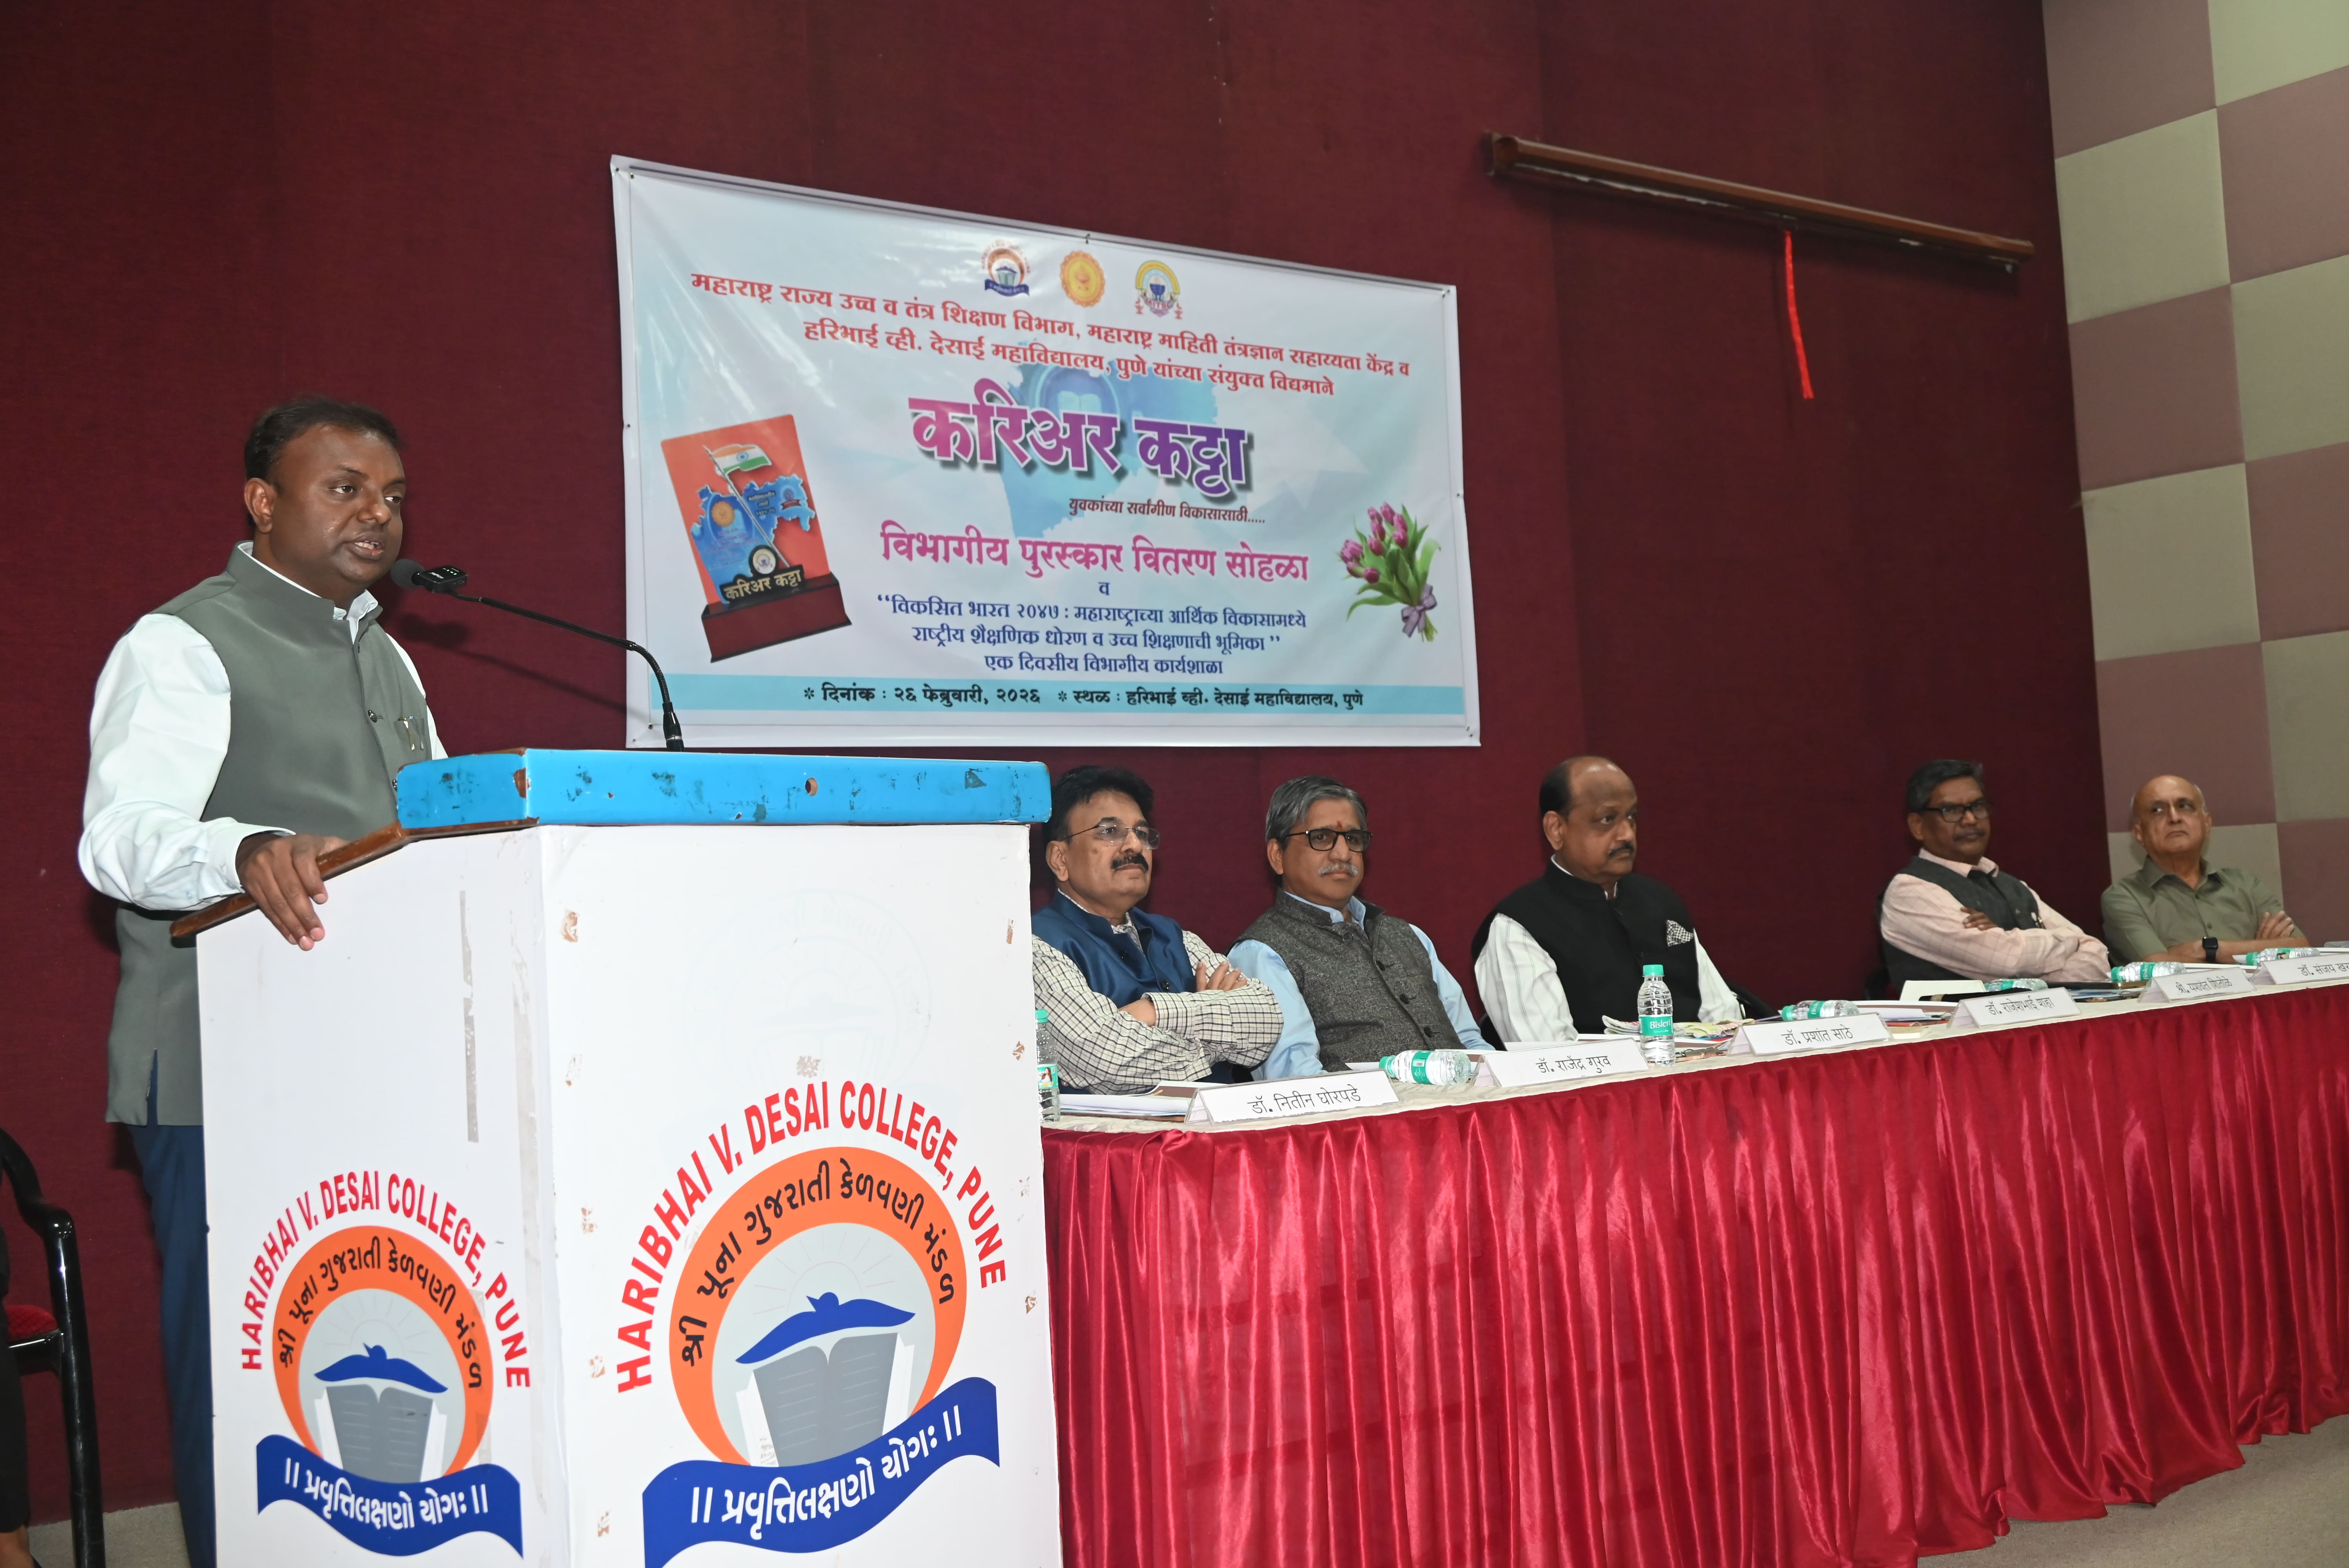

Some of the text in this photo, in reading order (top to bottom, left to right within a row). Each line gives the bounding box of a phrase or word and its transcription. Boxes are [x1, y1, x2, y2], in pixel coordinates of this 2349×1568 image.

[691, 273, 1410, 376] महाराष्ट्र राज्य उच्च व तंत्र शिक्षण विभाग, महाराष्ट्र माहिती तंत्रज्ञान सहाय्यता केंद्र व
[803, 317, 1334, 395] हरिभाई व्ही. देसाई महाविद्यालय, पुणे यांच्या संयुक्त विद्यमाने
[908, 377, 1249, 497] करिअर कट्टा
[1069, 496, 1123, 515] युवकांच्या
[880, 520, 1308, 582] विभागीय पुरस्कार वितरण सोहळा
[724, 570, 802, 599] करिअर कट्टा
[1099, 582, 1110, 595] व
[969, 602, 1010, 617] भारत
[1017, 604, 1059, 618] २०४७
[1074, 606, 1163, 626] महाराष्ट्राच्या
[1169, 606, 1218, 624] आर्थिक
[1223, 608, 1306, 627] विकासामध्ये
[912, 623, 964, 647] राष्ट्रीय
[971, 624, 1039, 646] शैक्षणिक
[1045, 626, 1087, 645] धोरण
[1093, 632, 1103, 647] व
[1109, 633, 1137, 647] उच्च
[1143, 629, 1211, 650] शिक्षणाची
[1216, 632, 1265, 655] भूमिका
[984, 651, 1223, 674] एक दिवसीय विभागीय कार्यशाळा
[822, 682, 875, 702] दिनांक
[894, 688, 917, 702] २६
[922, 683, 989, 707] फेब्रुवारी,
[996, 689, 1041, 703] २०२६
[1073, 691, 1110, 704] स्थळ
[1126, 688, 1176, 706] हरिभाई
[1182, 690, 1208, 706] व्ही.
[1214, 688, 1250, 707] देसाई
[1254, 690, 1338, 707] महाविद्यालय,
[1343, 690, 1363, 711] पुणे
[2298, 964, 2314, 976] डॉ.
[2313, 964, 2336, 974] संजय
[1985, 996, 2055, 1015] डॉ. राजेशभाई शहा
[1650, 1019, 1671, 1030] Bisleri
[1781, 1024, 1854, 1045] डॉ. प्रशांत साठे
[1535, 1055, 1611, 1073] डॉ. राजेंद्र गुरव
[1247, 1084, 1361, 1114] डॉ. नितीन घोरपडे
[617, 1081, 1006, 1393] HARIBHAI V. DESAI COLLEGE, PUNE
[679, 1158, 955, 1367] શ્રી પૂના ગુજરાતી કેળવણી મંડળ
[242, 1171, 531, 1388] HARIBHAI V. DESAI COLLEGE, PUNE
[278, 1236, 482, 1388] શ્રી પૂના ગુજરાતી કેળવણી મંડળ
